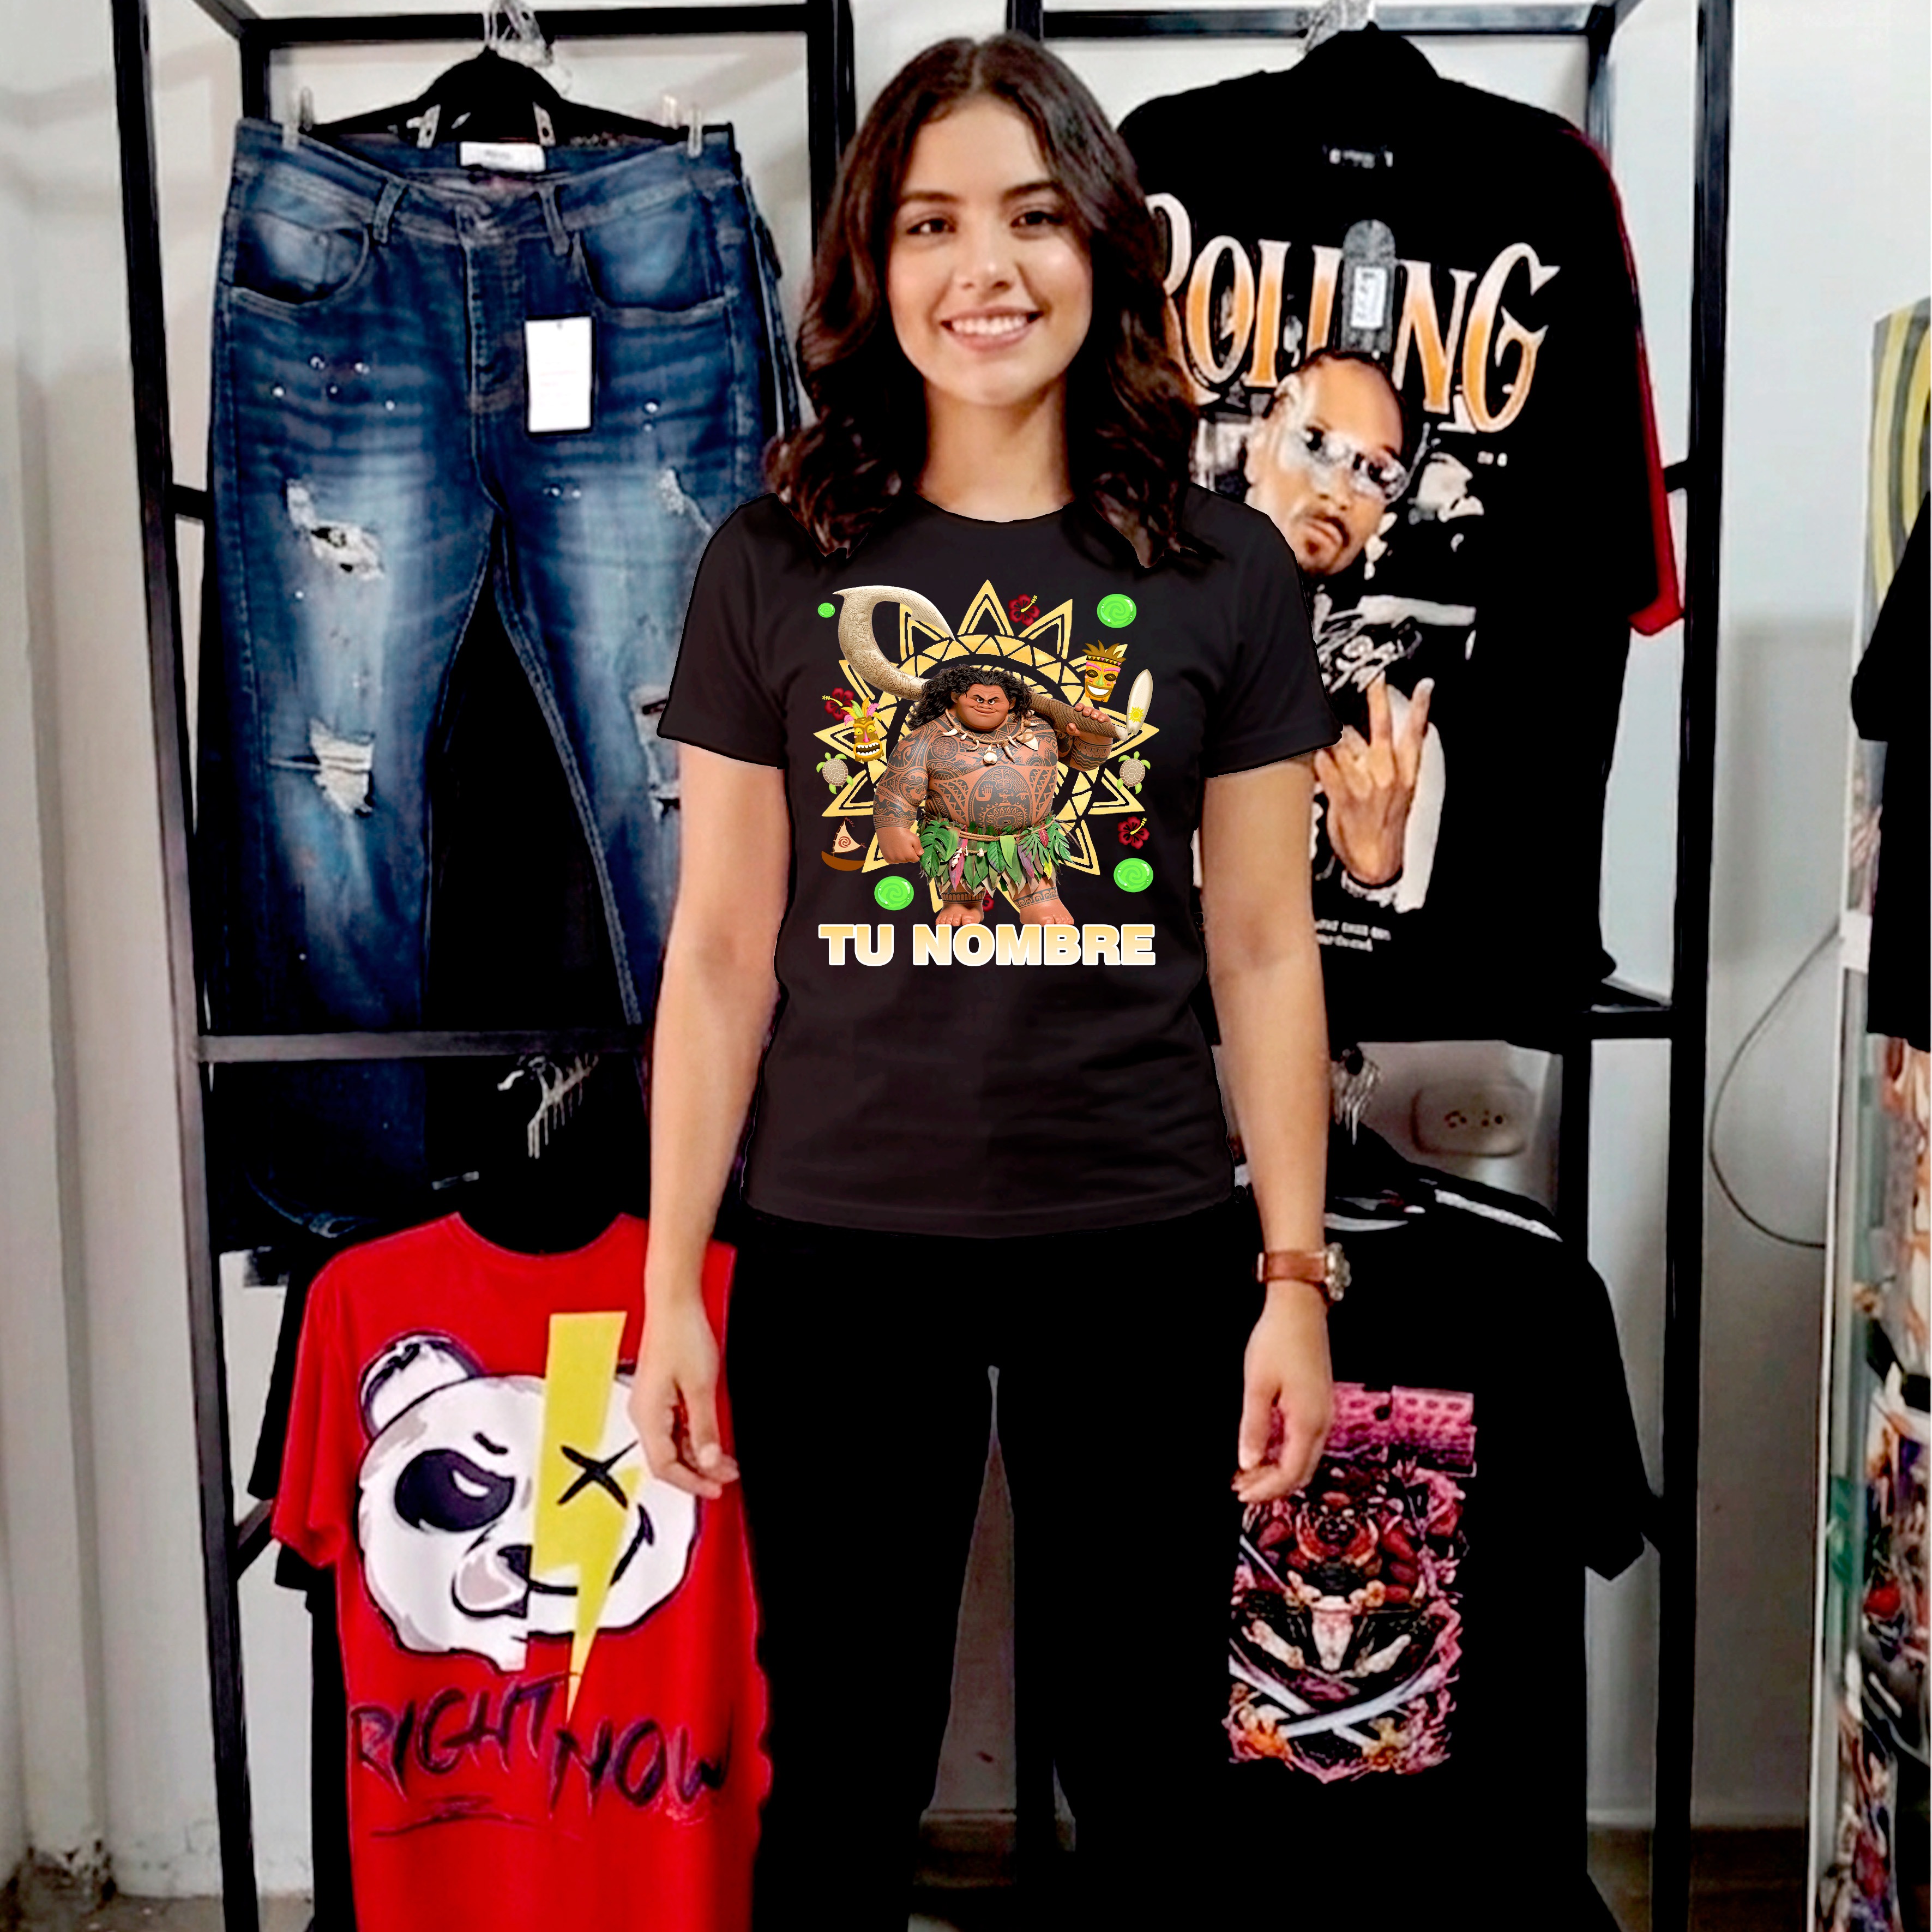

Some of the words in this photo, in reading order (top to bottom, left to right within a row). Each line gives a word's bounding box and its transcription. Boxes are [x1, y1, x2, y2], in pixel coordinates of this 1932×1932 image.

[1144, 191, 1561, 434] ROLLNG
[818, 923, 894, 967] TU
[912, 923, 1156, 967] NOMBRE
[350, 1672, 569, 1801] RIGHT
[549, 1706, 733, 1817] NOW
